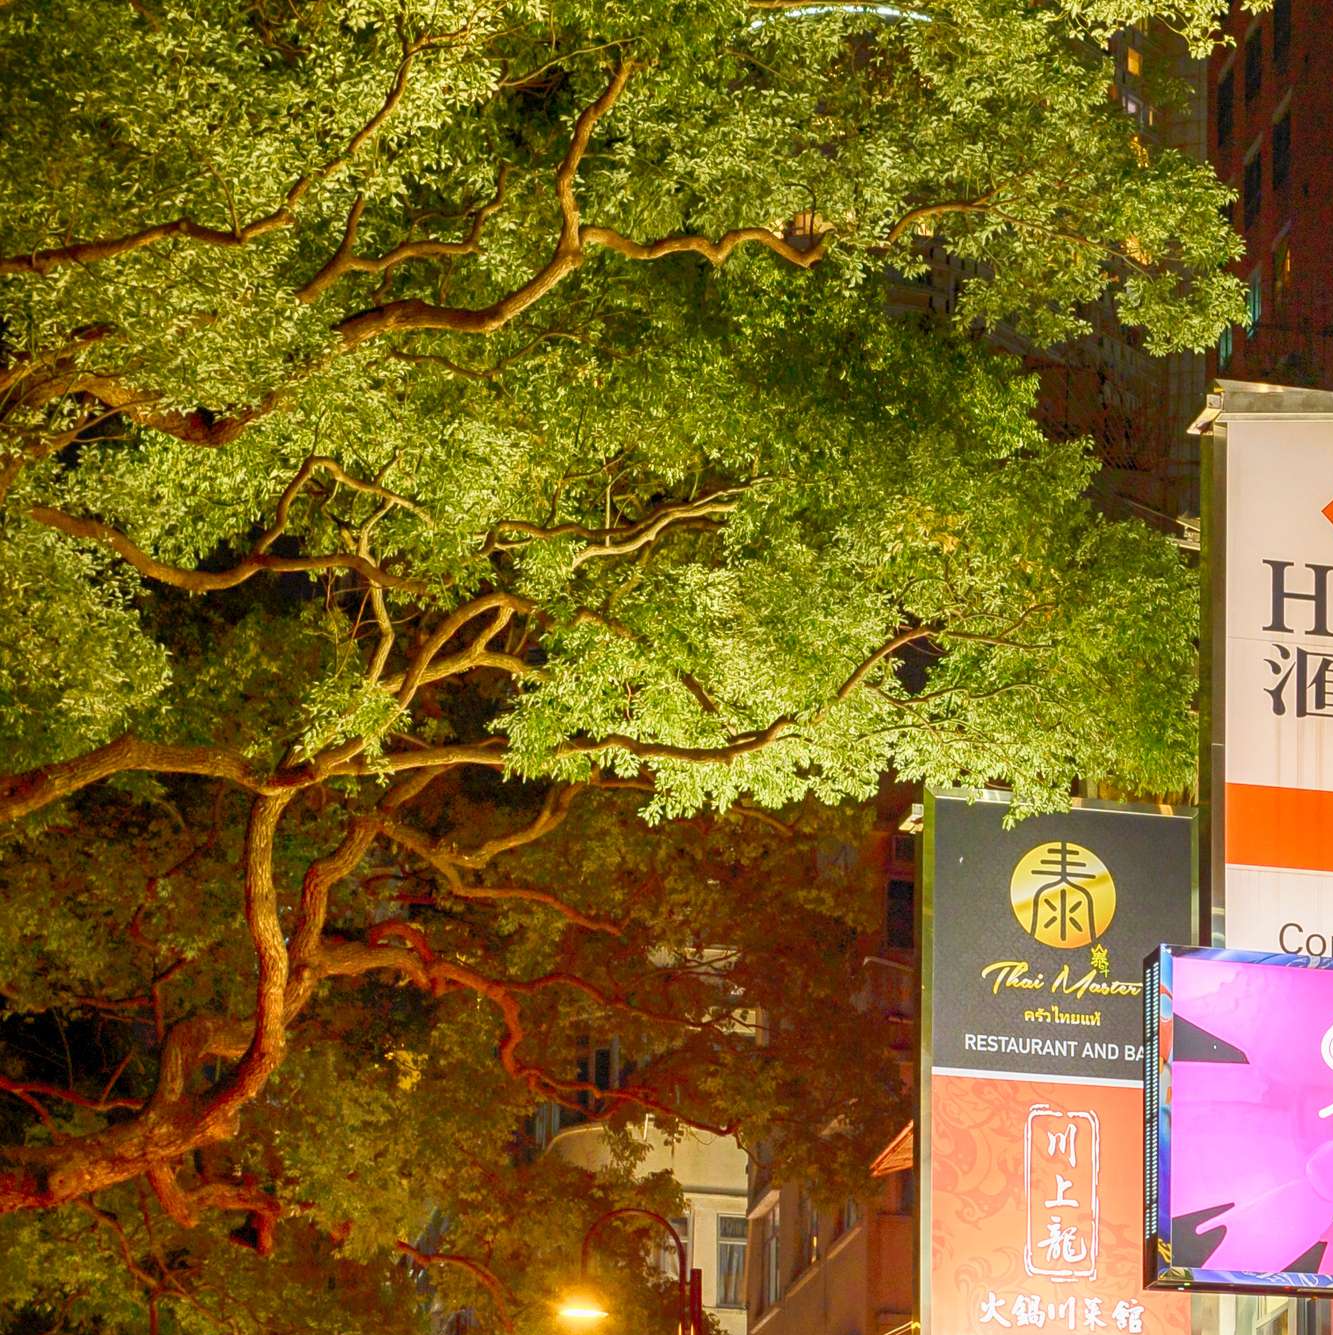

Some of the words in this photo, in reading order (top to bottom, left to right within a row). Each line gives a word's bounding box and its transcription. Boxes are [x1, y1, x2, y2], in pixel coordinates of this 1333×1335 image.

[981, 960, 1045, 996] Thai
[1051, 964, 1144, 999] Master
[964, 1033, 1079, 1059] RESTAURANT
[1082, 1040, 1120, 1061] AND
[1037, 1123, 1089, 1264] 川上龍
